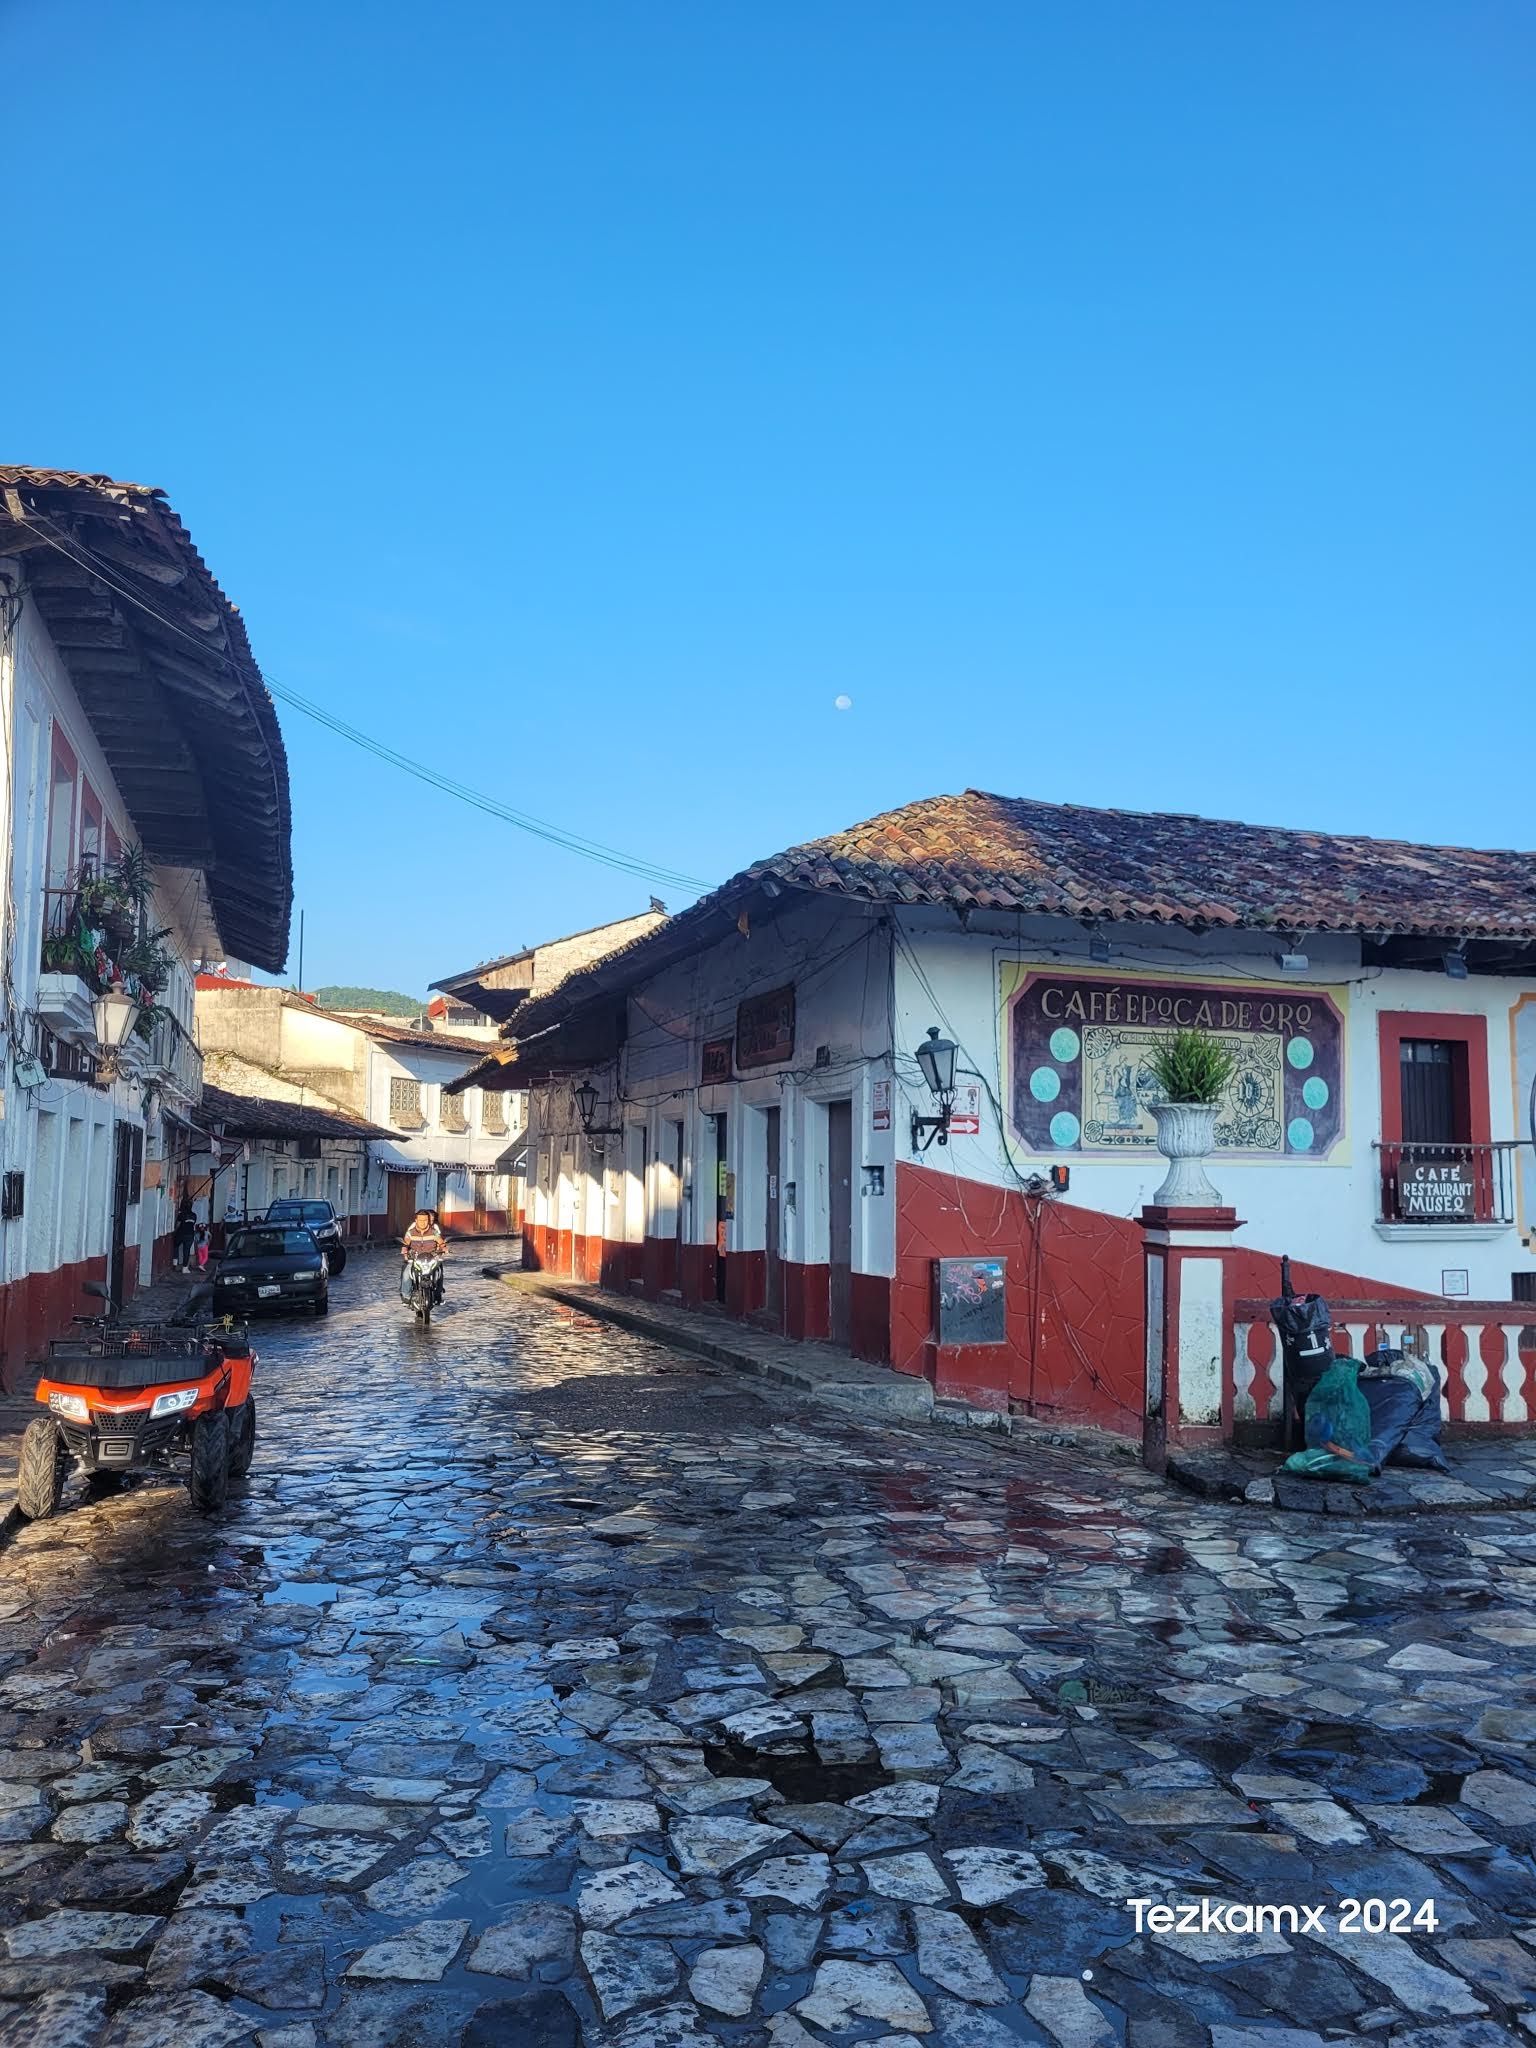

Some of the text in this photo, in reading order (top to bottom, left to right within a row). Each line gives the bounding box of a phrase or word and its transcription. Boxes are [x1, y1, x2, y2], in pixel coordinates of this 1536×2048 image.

[1041, 987, 1312, 1036] CAFÉ EPOCA DE ORO
[1415, 1165, 1460, 1181] CAFÉ
[1403, 1182, 1472, 1197] RESTAURANT
[1409, 1196, 1465, 1213] MUSEO
